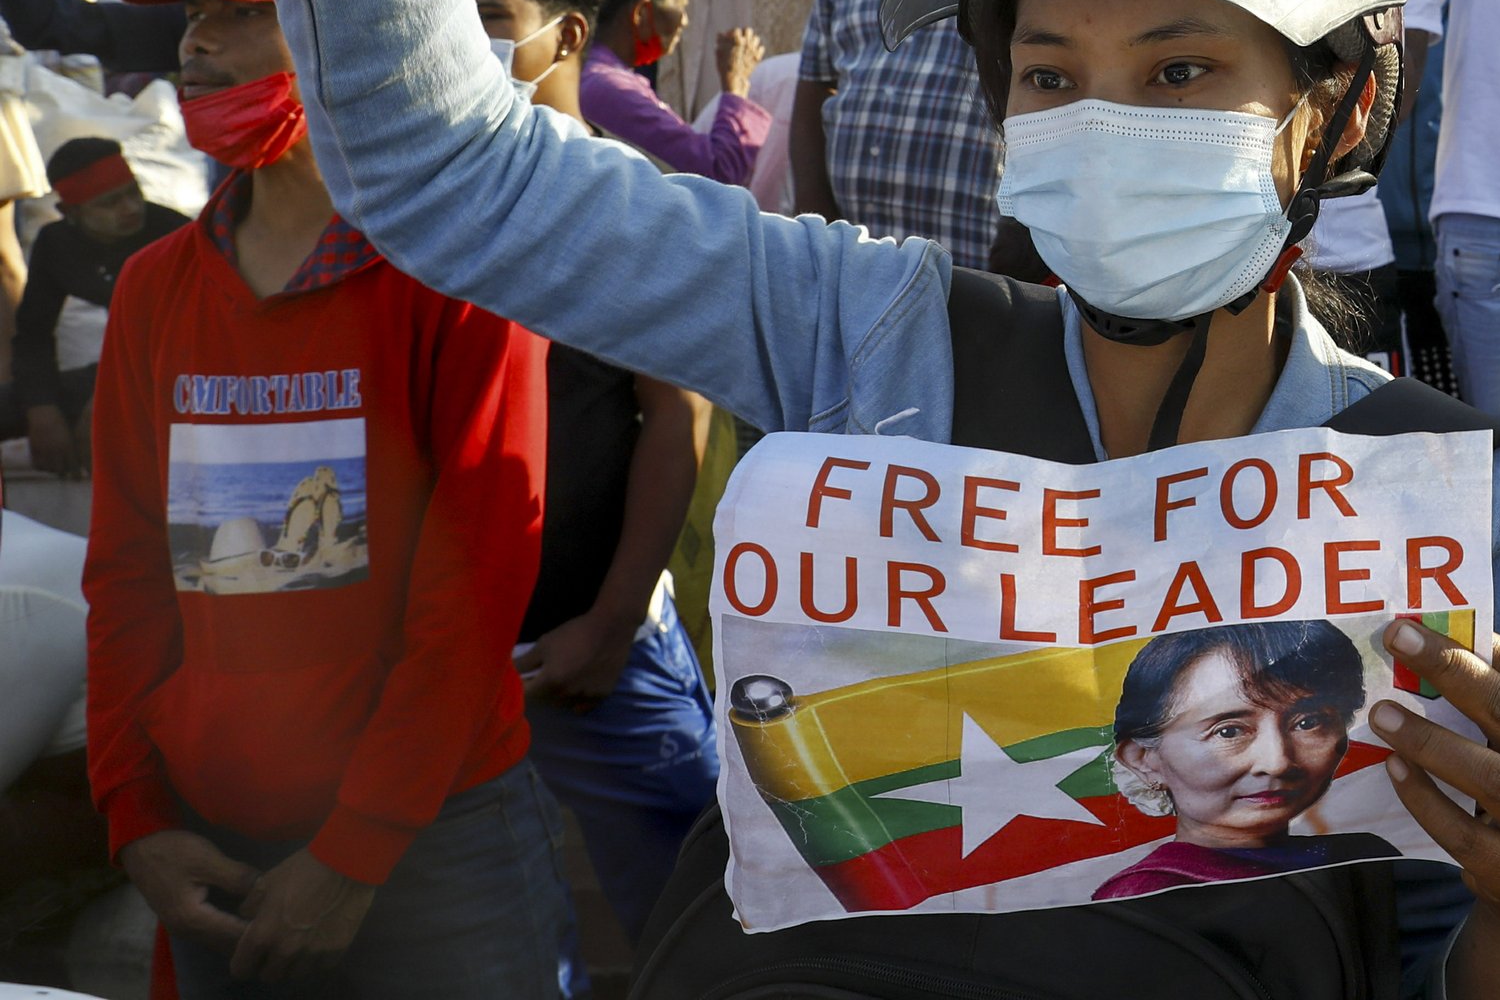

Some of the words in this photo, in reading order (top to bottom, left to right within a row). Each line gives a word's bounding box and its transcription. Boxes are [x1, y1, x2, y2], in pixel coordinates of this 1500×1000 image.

[805, 455, 1102, 557] FREE
[1153, 452, 1358, 543] FOR
[722, 540, 948, 633] OUR
[999, 535, 1469, 645] LEADER
